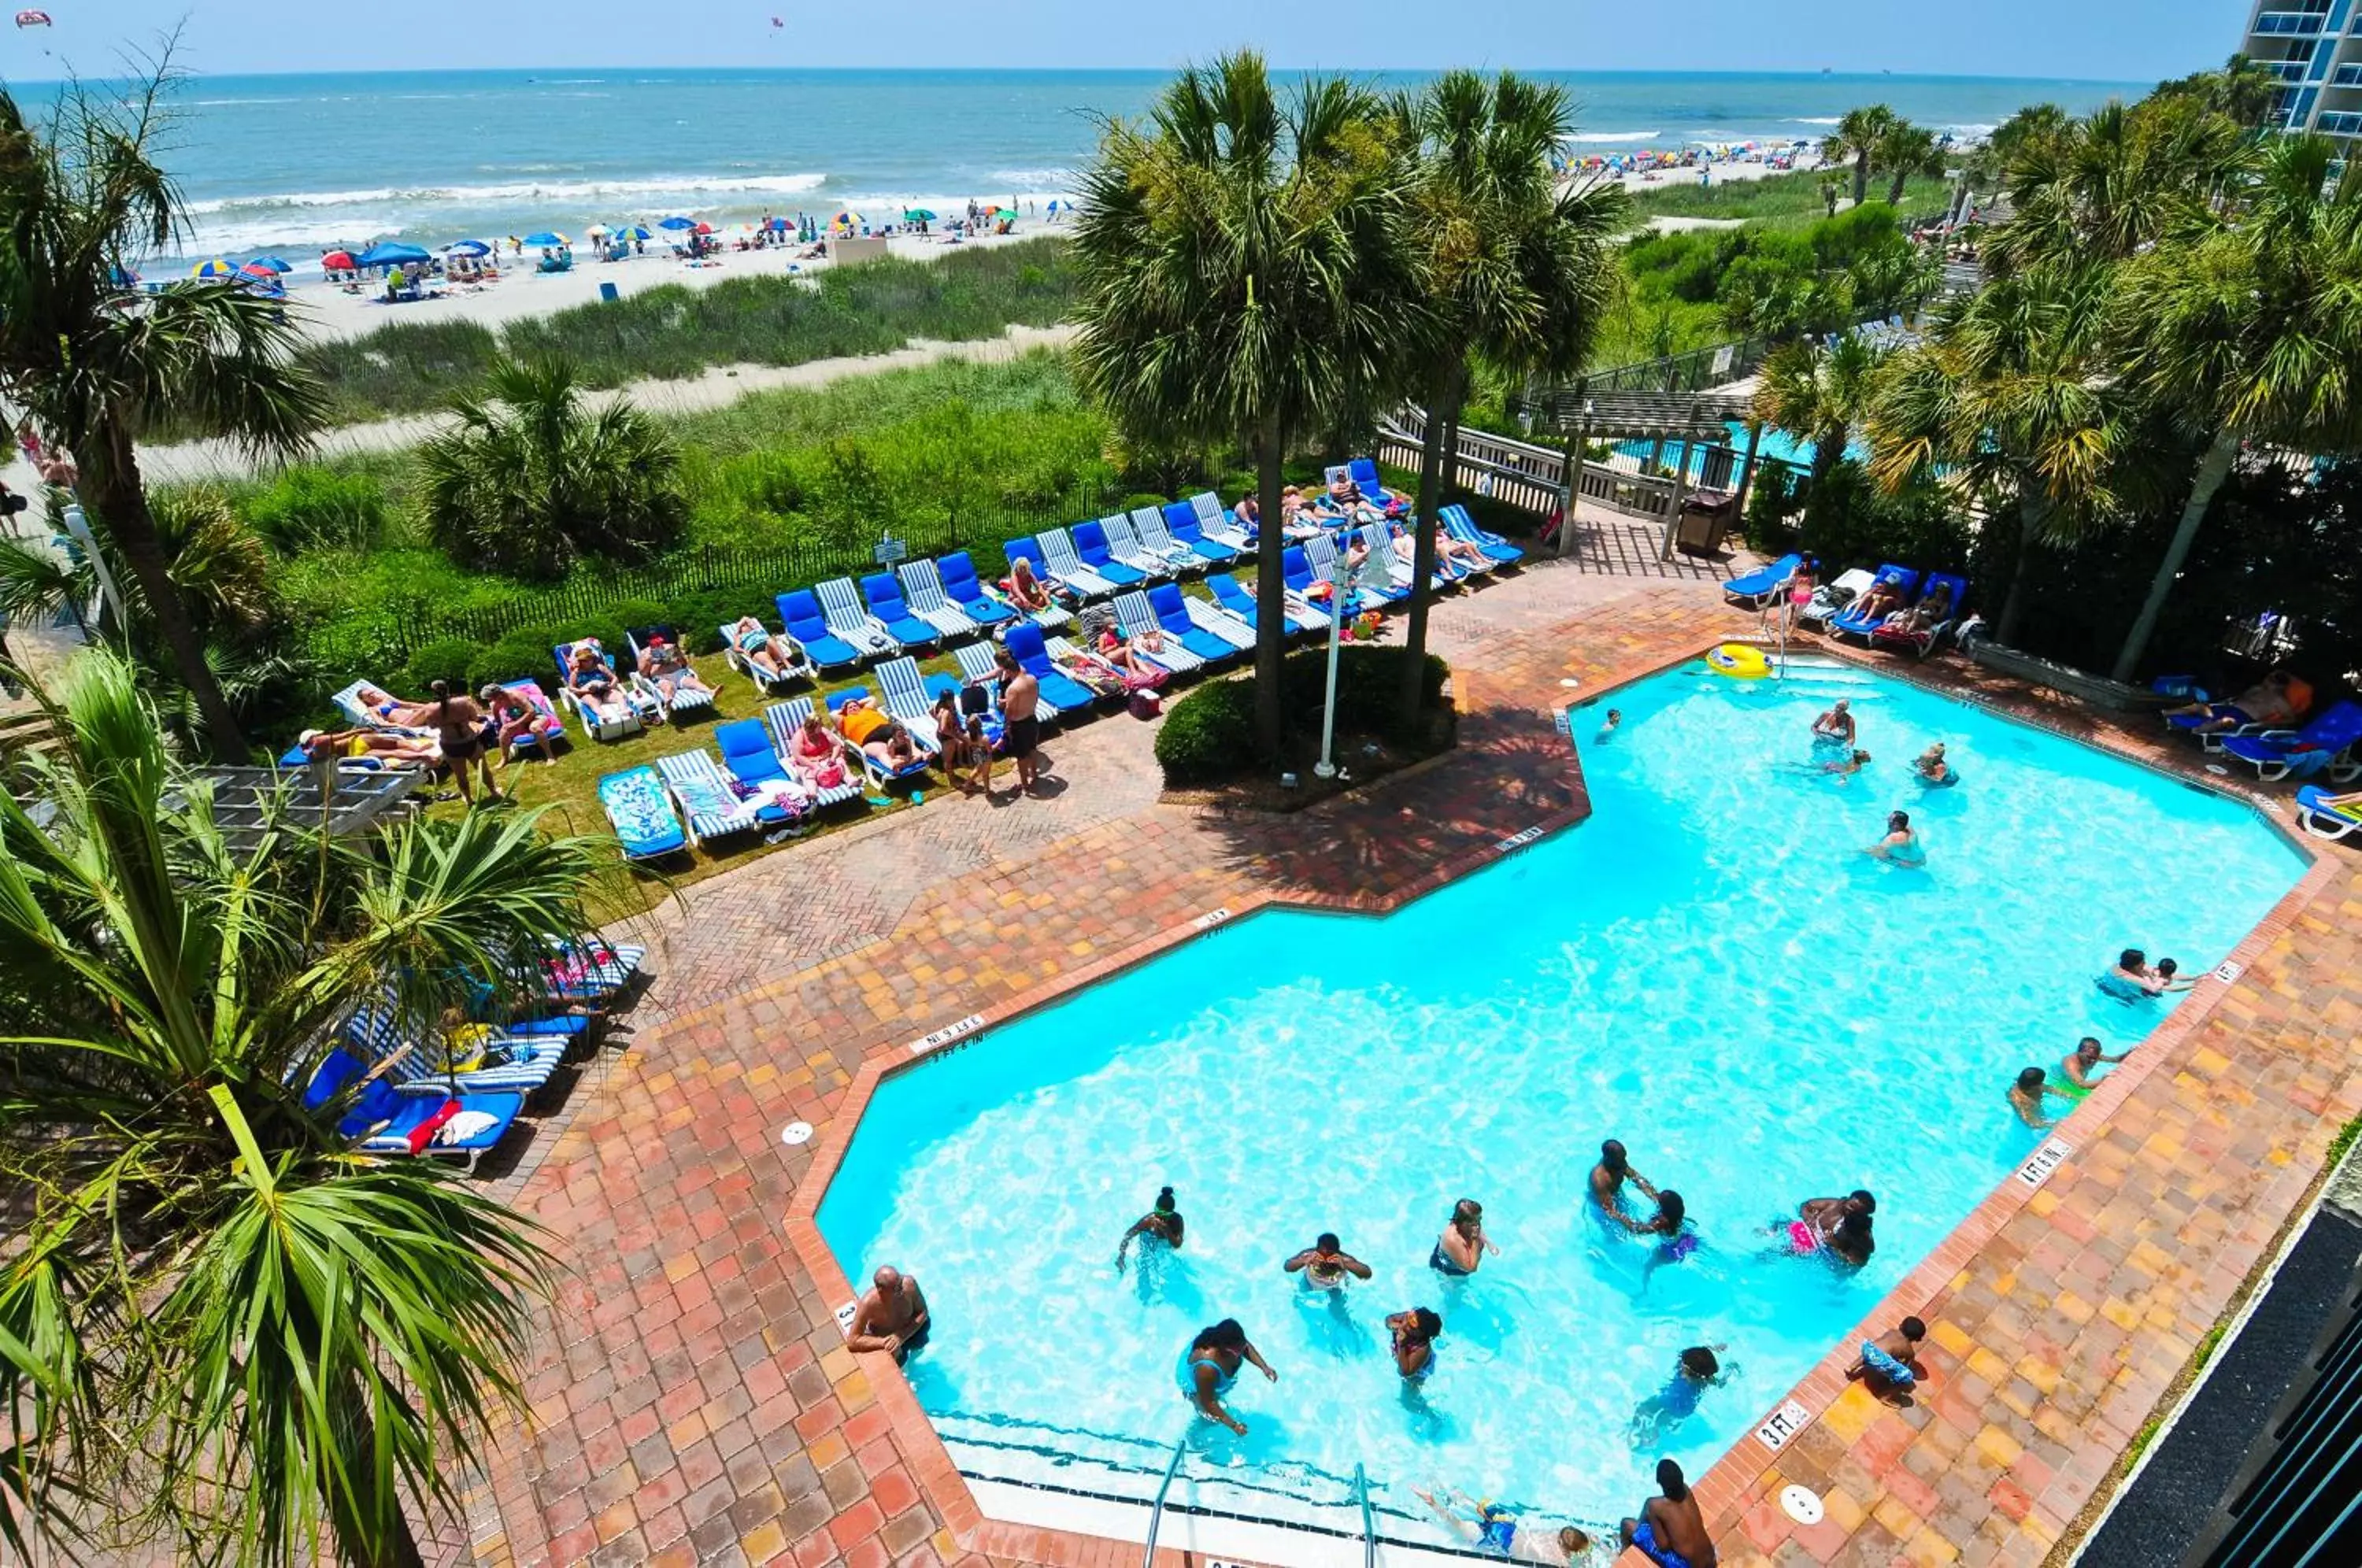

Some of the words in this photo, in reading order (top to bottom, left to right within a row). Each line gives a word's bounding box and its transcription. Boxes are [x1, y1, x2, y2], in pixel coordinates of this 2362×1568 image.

[954, 1022, 970, 1033] FT
[2026, 1162, 2047, 1178] FT
[1770, 1413, 1794, 1437] FT
[1761, 1429, 1780, 1445] 3
